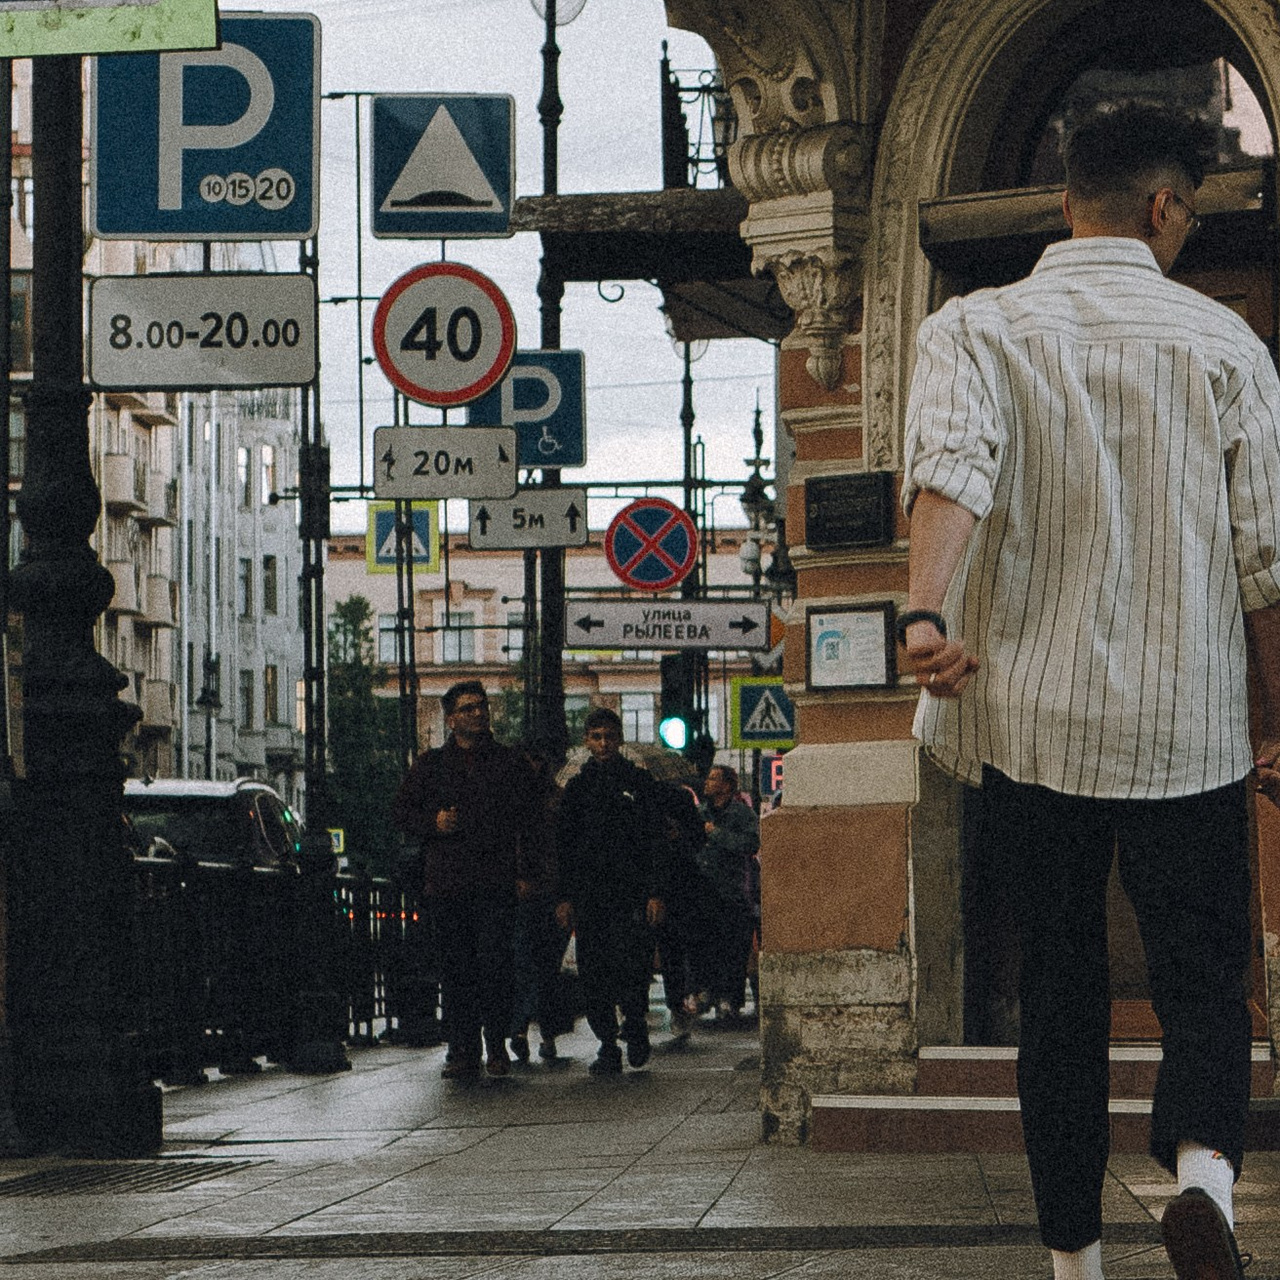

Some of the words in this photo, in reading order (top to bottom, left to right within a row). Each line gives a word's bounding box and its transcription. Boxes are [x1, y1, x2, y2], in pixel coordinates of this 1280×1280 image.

[158, 41, 275, 210] P
[205, 180, 222, 197] 10
[230, 178, 251, 199] 15
[258, 177, 292, 201] 20
[108, 311, 301, 350] 8.00-20.00
[399, 305, 483, 363] 40
[622, 623, 711, 640] РЫЛЕЕВА
[642, 609, 692, 625] улица
